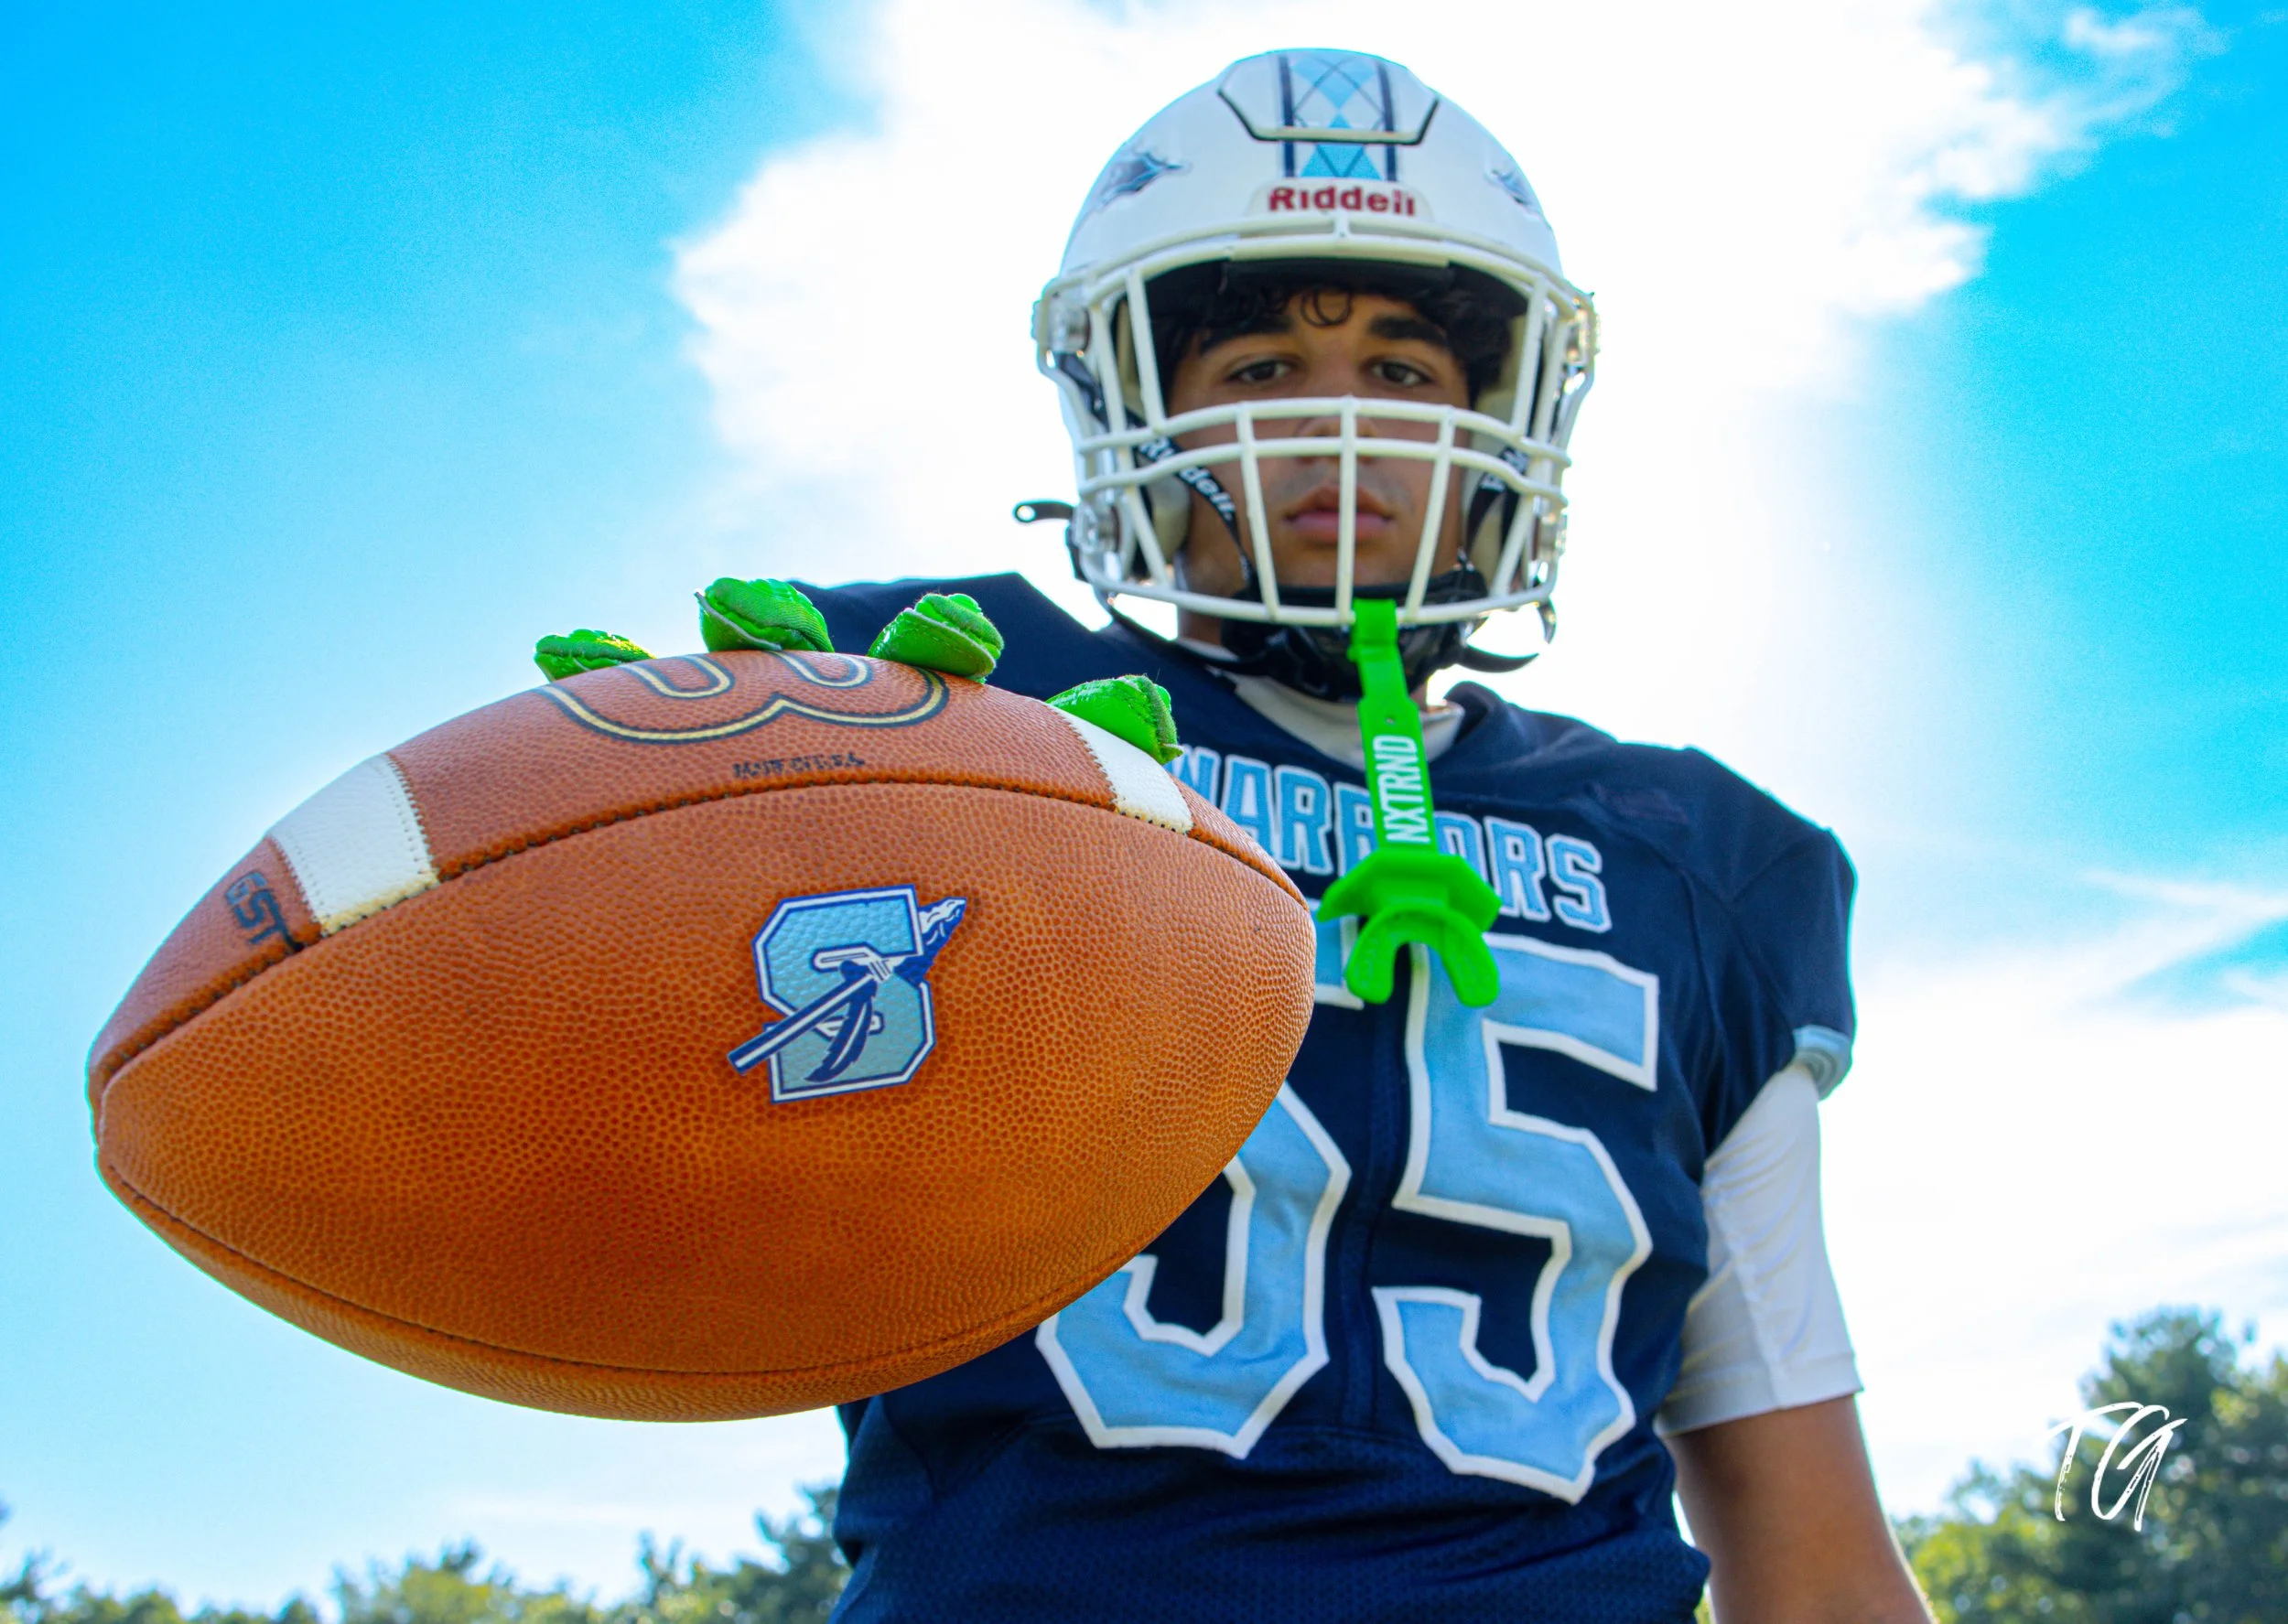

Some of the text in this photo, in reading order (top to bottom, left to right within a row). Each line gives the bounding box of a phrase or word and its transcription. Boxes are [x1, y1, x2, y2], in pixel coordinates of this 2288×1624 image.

[1269, 186, 1415, 217] Riddell
[1160, 743, 1613, 934] WARRORS
[1373, 735, 1431, 844] NXTRND
[224, 871, 306, 952] GST
[751, 884, 937, 1104] S
